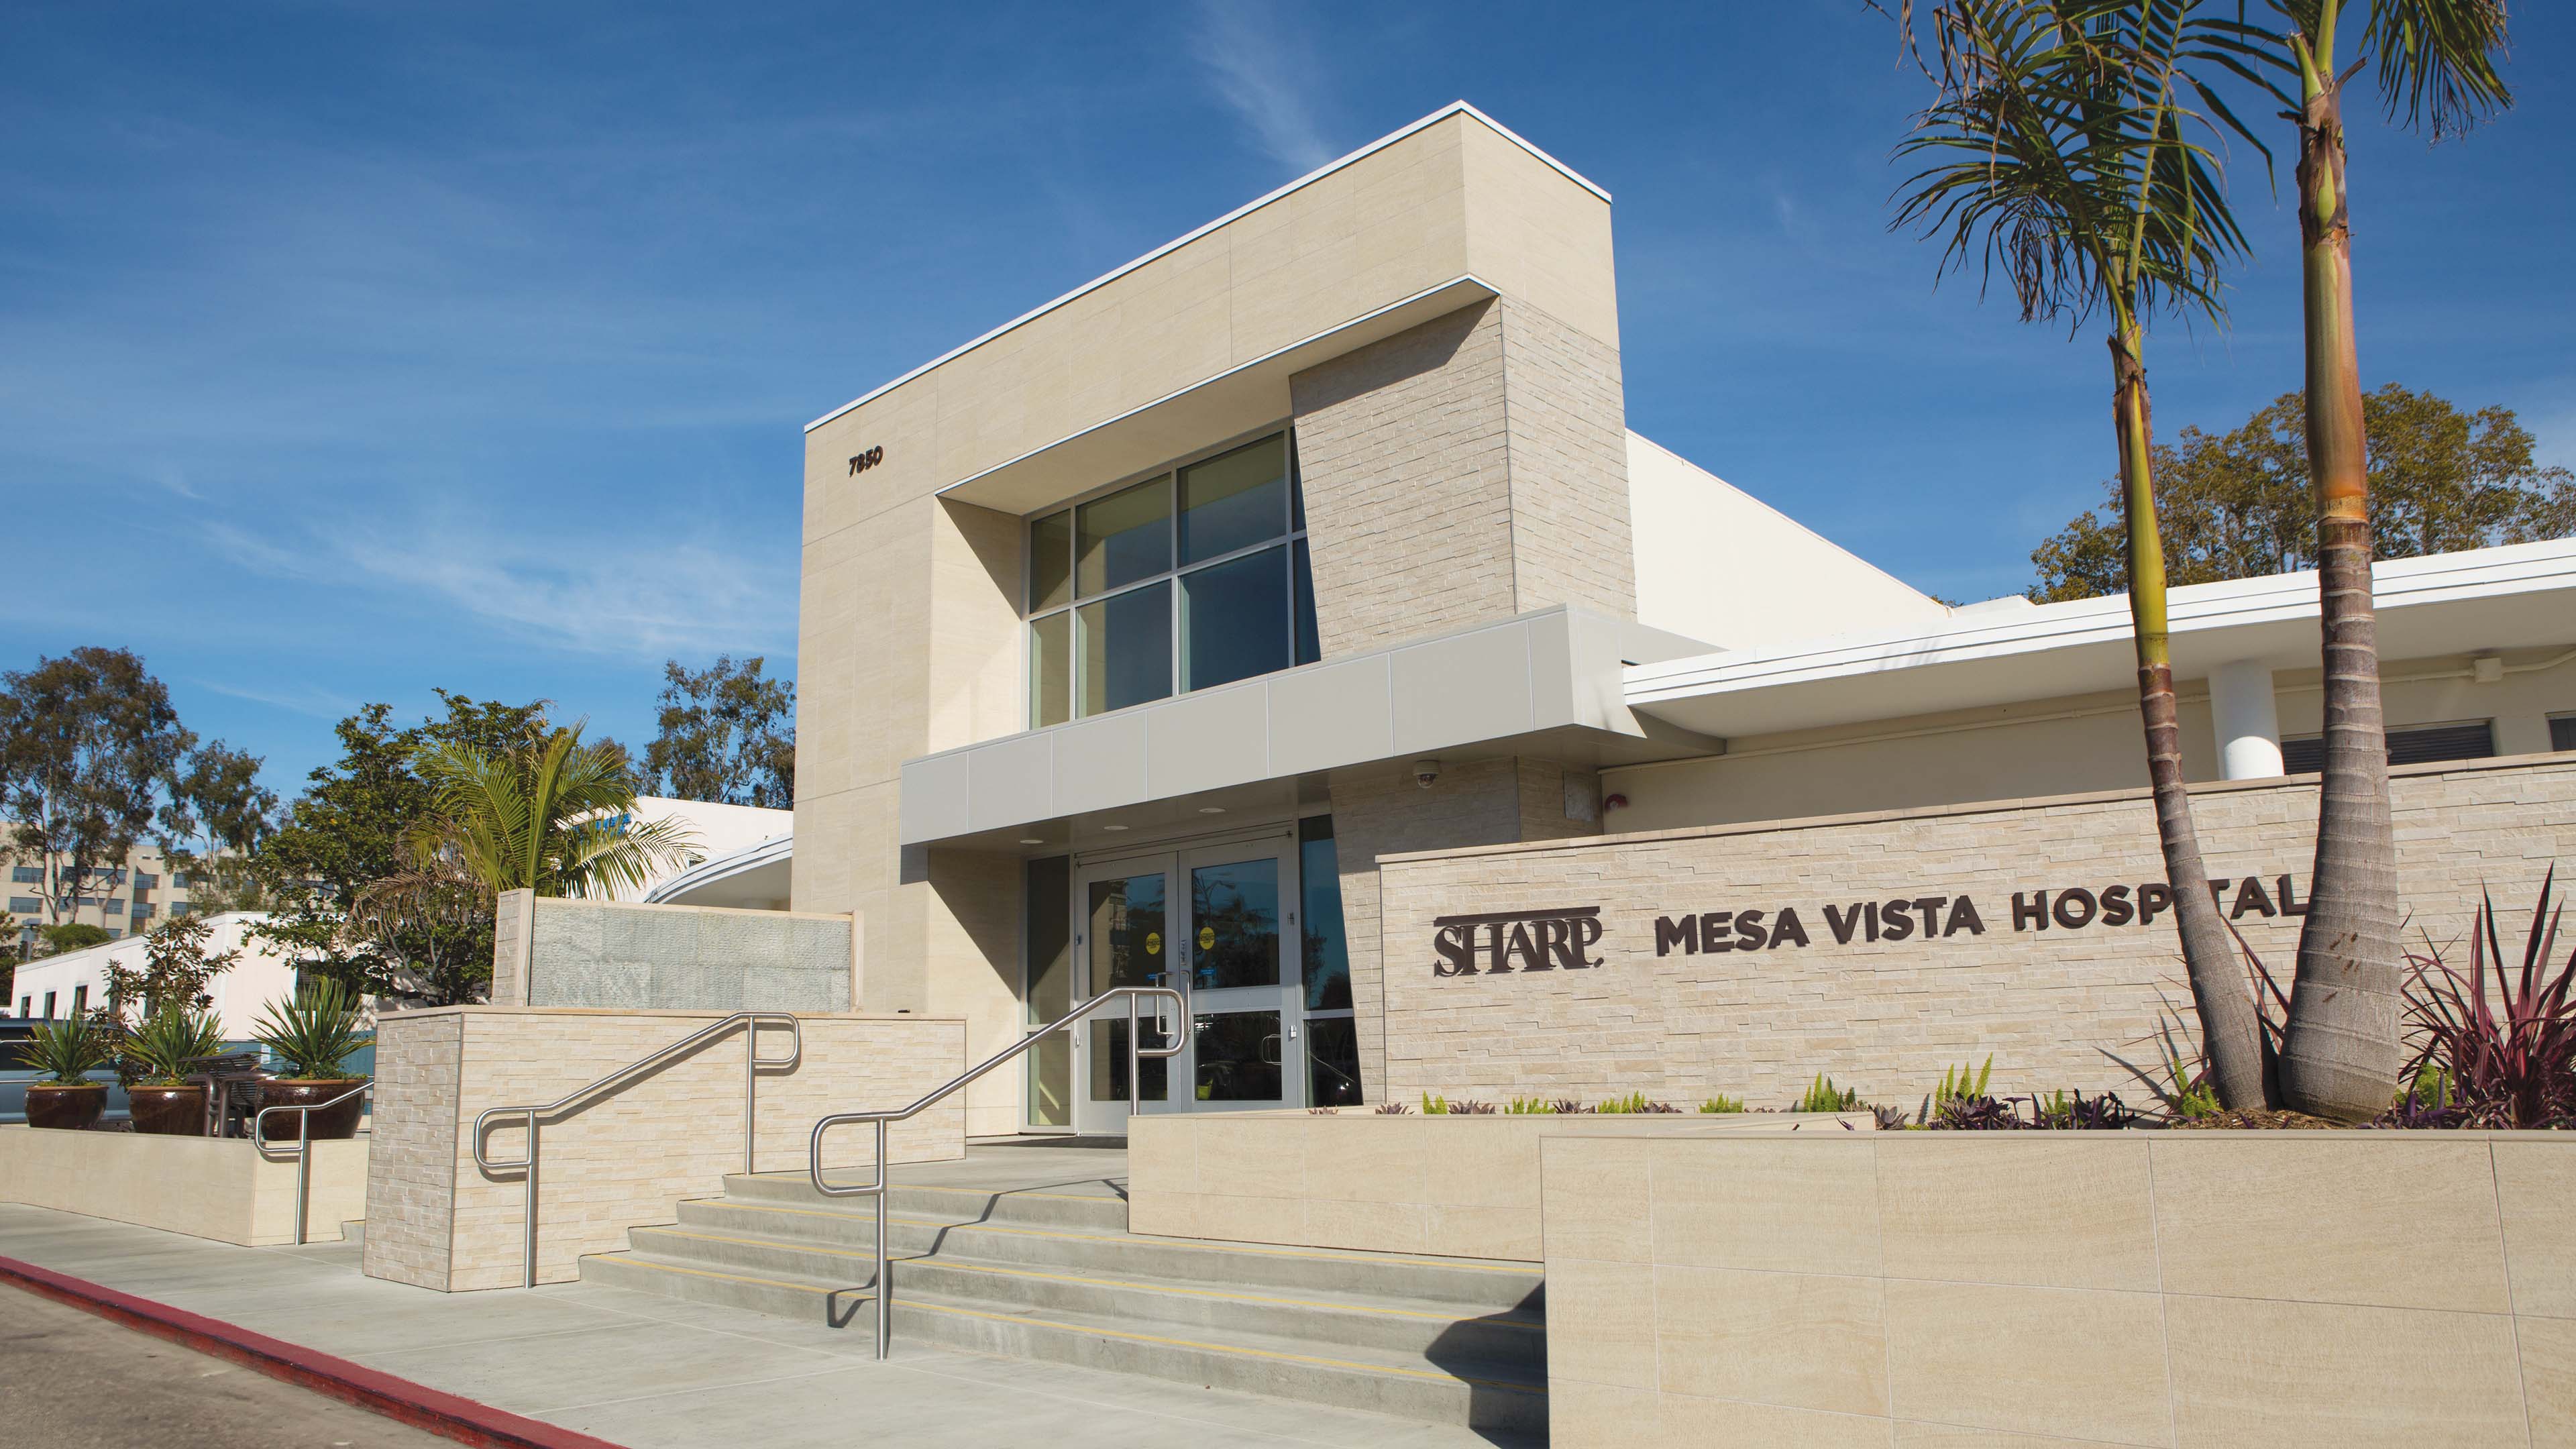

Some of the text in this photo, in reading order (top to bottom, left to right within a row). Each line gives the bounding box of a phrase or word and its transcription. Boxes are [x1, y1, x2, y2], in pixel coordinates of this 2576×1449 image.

[849, 445, 883, 478] 7850
[1655, 907, 1811, 957] MESA
[1822, 895, 1986, 945] VISTA
[2012, 873, 2310, 932] HOSPTAL
